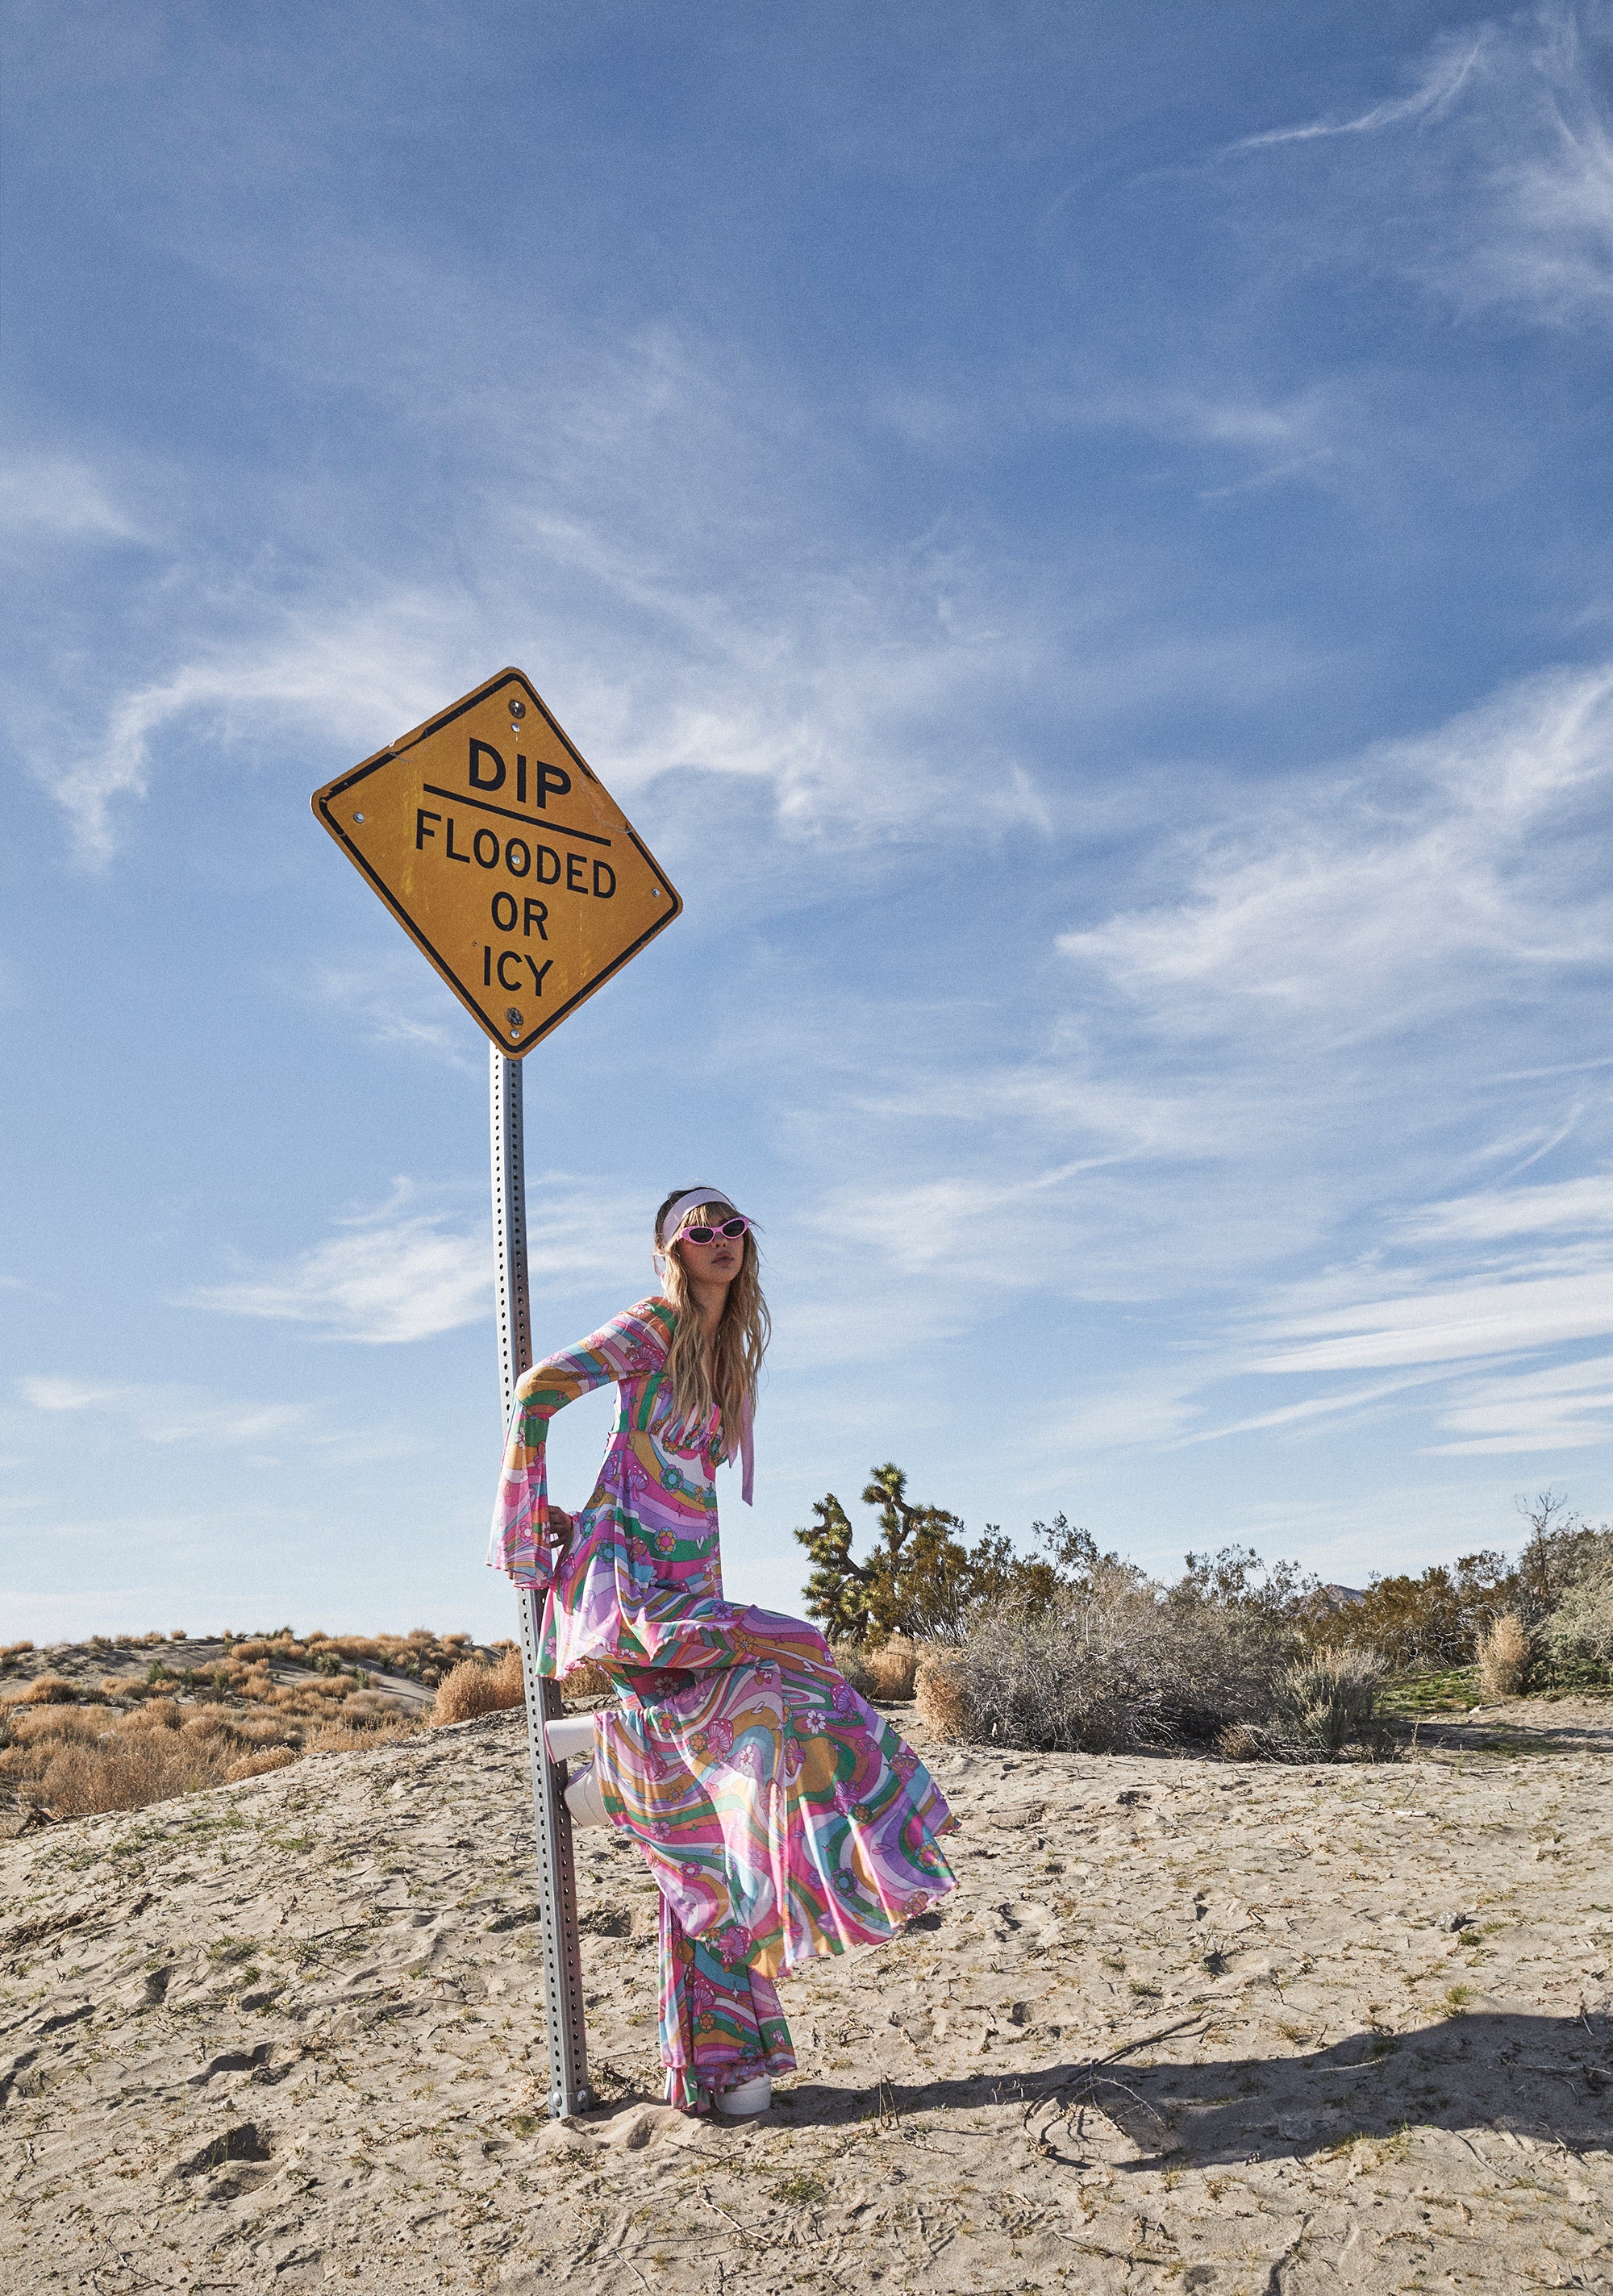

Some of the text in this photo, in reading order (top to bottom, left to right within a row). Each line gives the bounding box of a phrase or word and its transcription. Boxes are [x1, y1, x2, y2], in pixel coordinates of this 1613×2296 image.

[469, 737, 572, 809] DIP
[415, 808, 617, 899] FLOODED
[491, 891, 549, 941] OR
[484, 945, 554, 997] ICY
